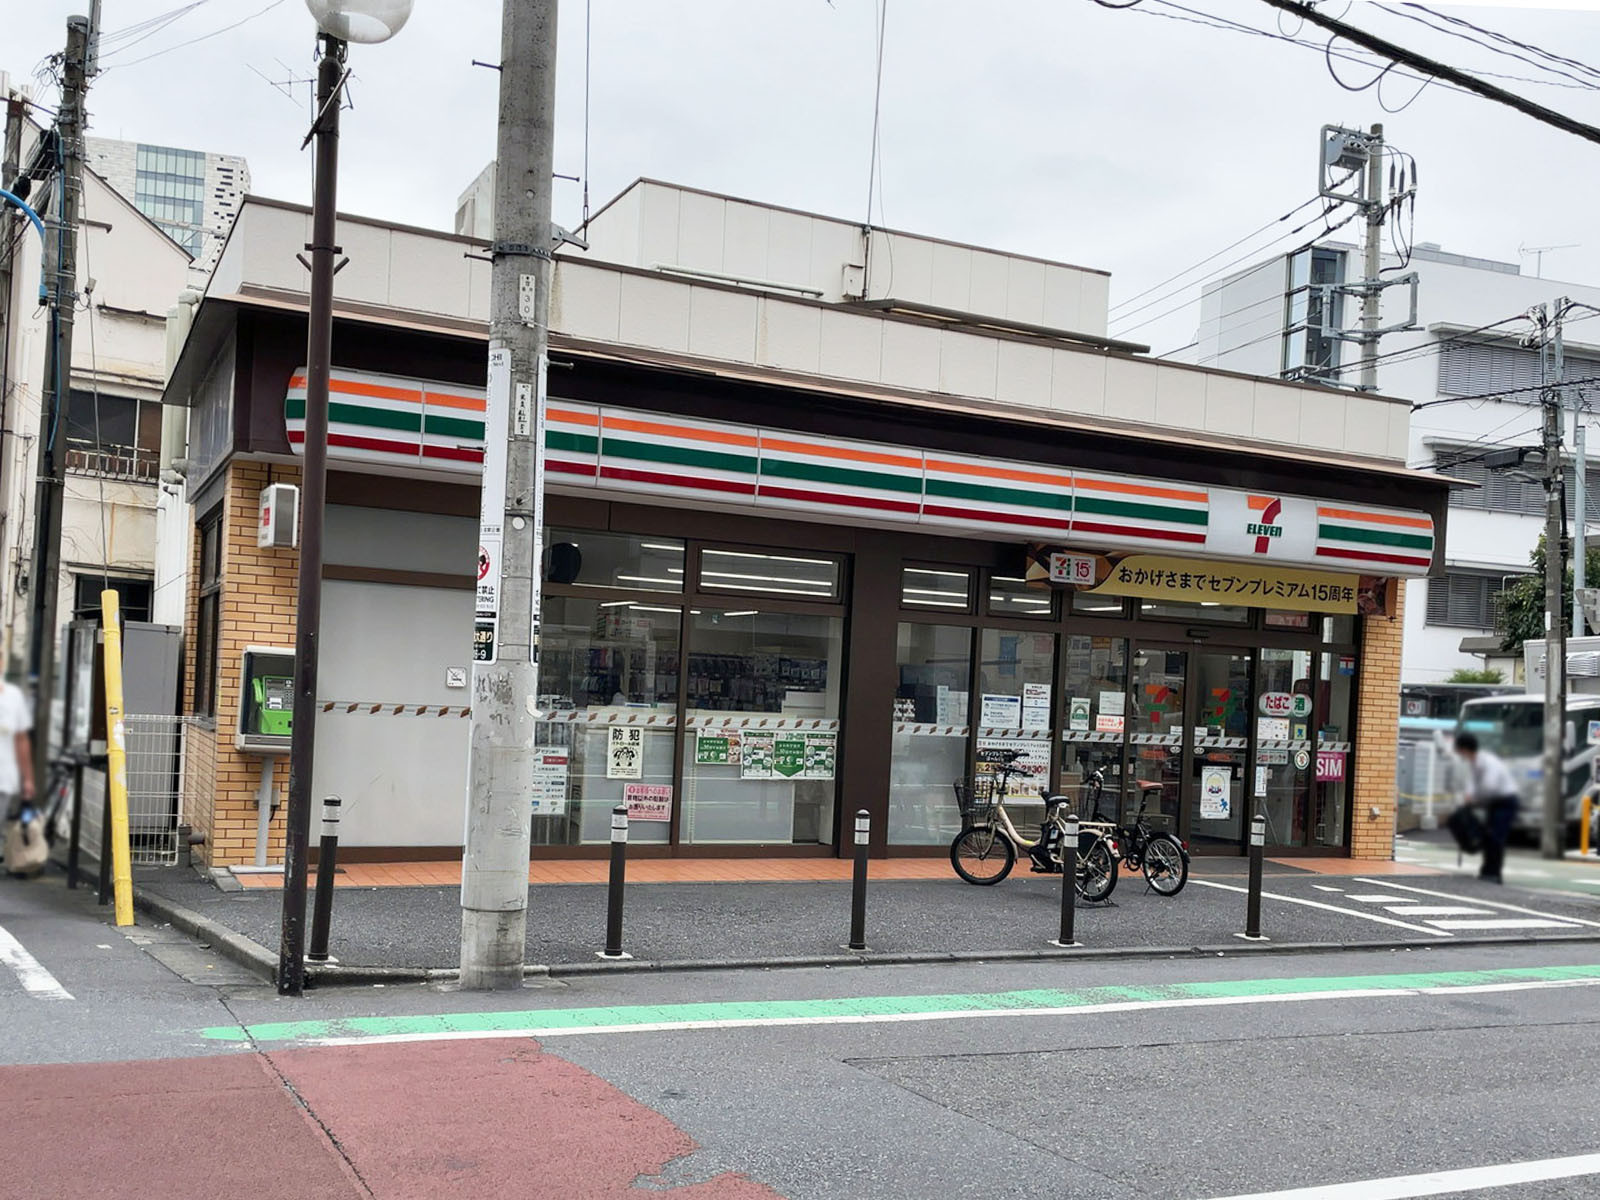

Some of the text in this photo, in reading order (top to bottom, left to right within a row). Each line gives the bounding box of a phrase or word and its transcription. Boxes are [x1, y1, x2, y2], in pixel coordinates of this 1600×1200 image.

[1247, 495, 1282, 554] 7
[1075, 561, 1090, 577] 15
[1118, 566, 1354, 602] おかげさまでセブンプレミアム15周年
[1265, 696, 1290, 710] たばこ
[1294, 697, 1305, 711] 酒
[612, 728, 640, 741] 防犯
[1316, 758, 1342, 776] SIM
